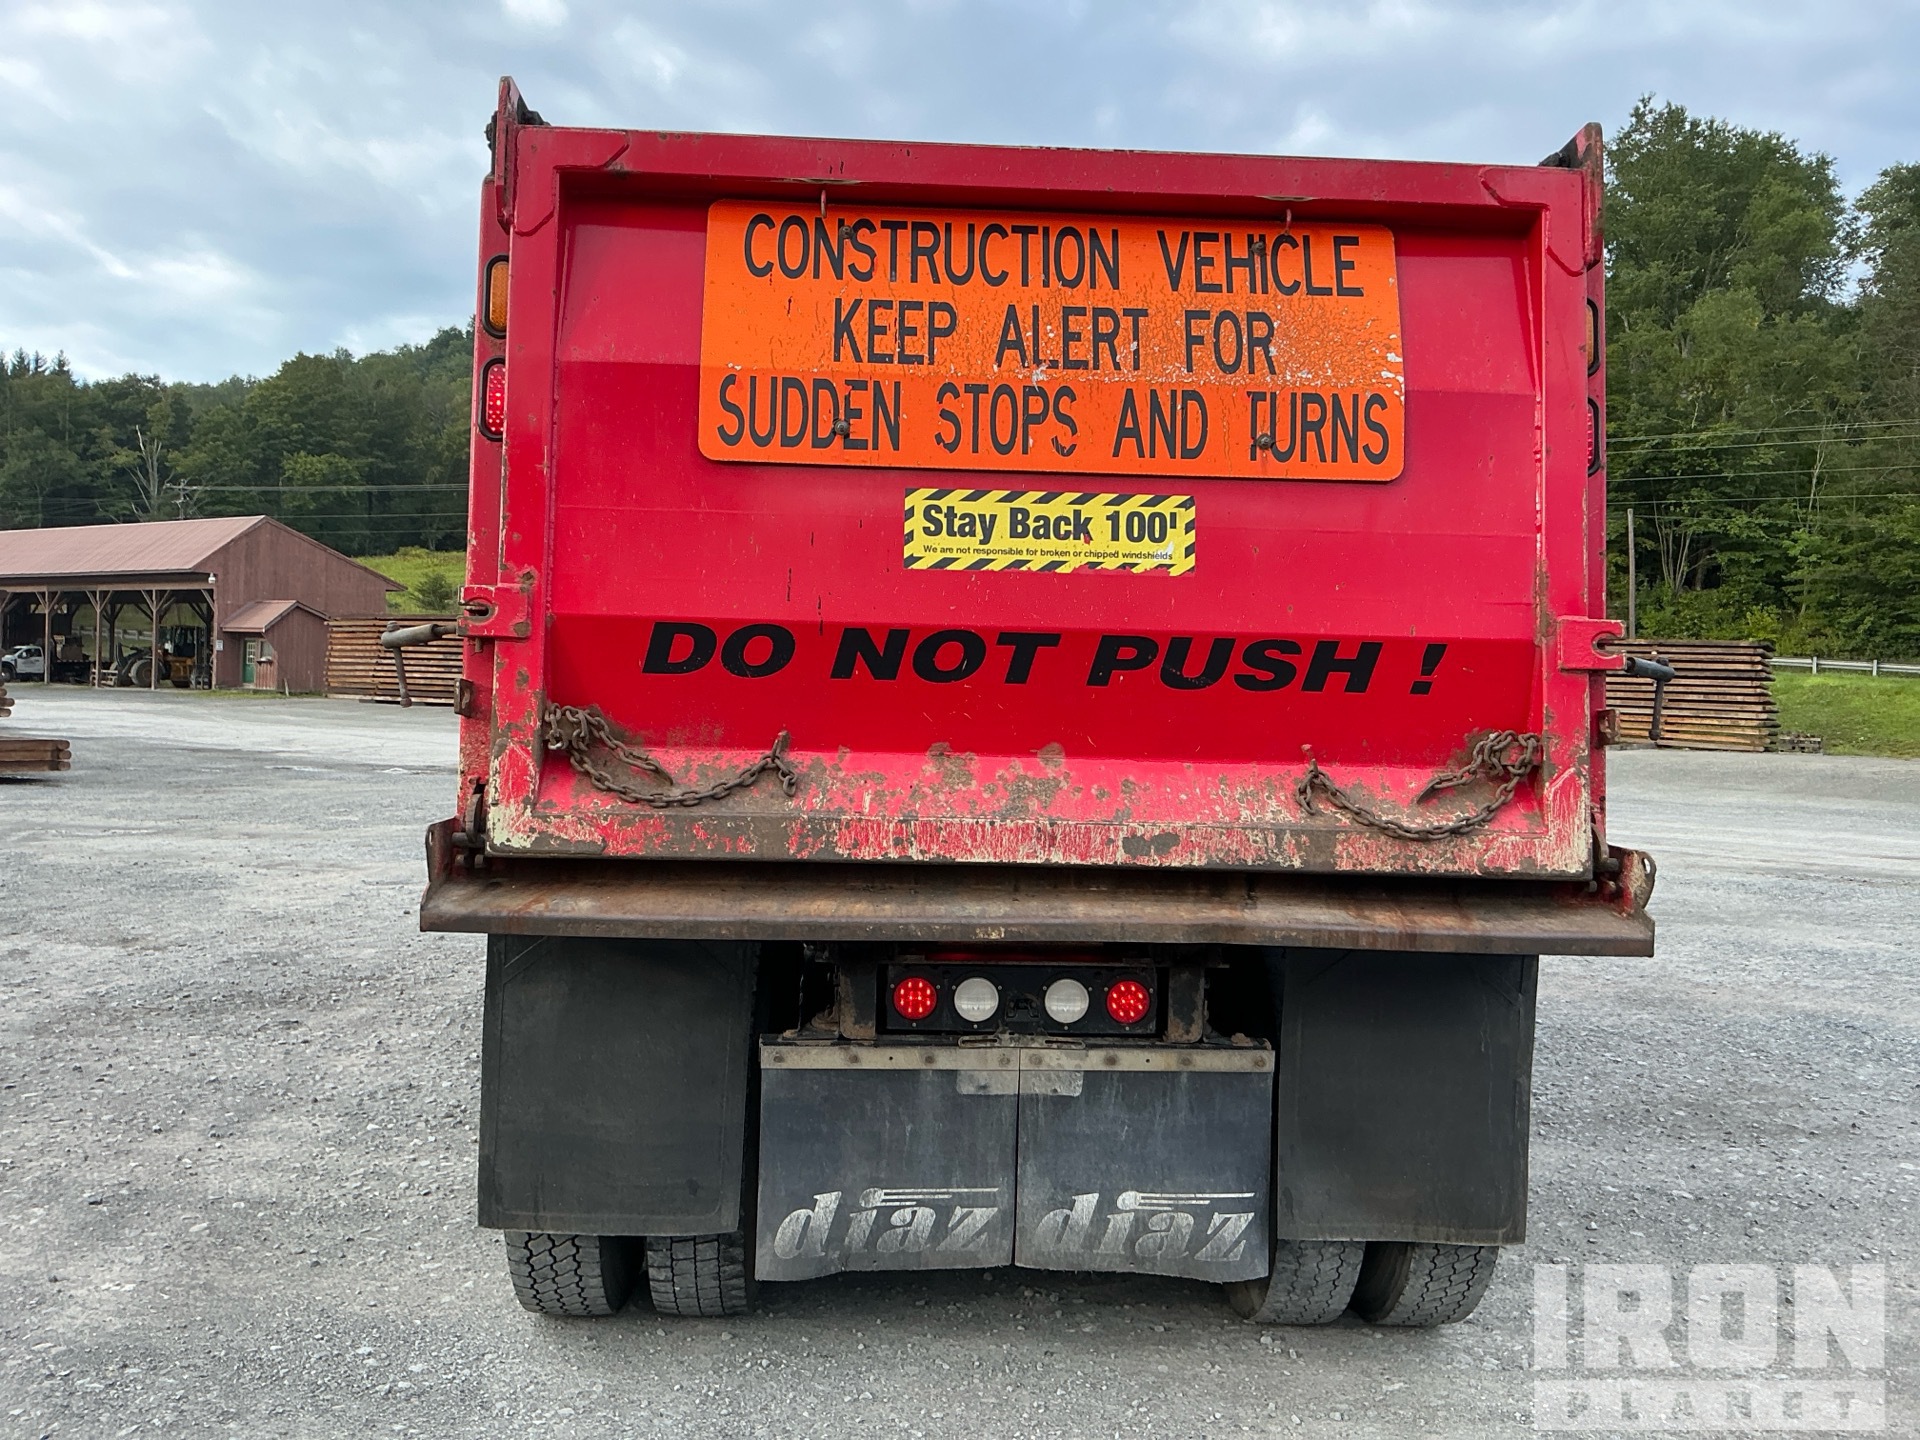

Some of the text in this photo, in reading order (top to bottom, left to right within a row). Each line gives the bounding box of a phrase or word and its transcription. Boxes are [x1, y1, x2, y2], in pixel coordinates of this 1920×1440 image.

[744, 213, 1364, 298] CONSTRUCTION VEHICLE
[833, 297, 1277, 376] KEEP ALERT FOR
[717, 373, 1390, 465] SUDDEN STOPS AND TURNS
[922, 504, 1177, 545] Stay Back 100'
[923, 544, 938, 554] We
[940, 546, 954, 554] are
[956, 545, 971, 555] not
[973, 547, 1024, 556] responsible
[1026, 548, 1039, 556] for
[1040, 549, 1070, 557] broken
[1084, 549, 1119, 560] chipped
[1122, 550, 1173, 561] windshields
[642, 621, 1447, 695] DO NOT PUSH !
[773, 1187, 999, 1260] diaz
[1037, 1190, 1256, 1262] diaz
